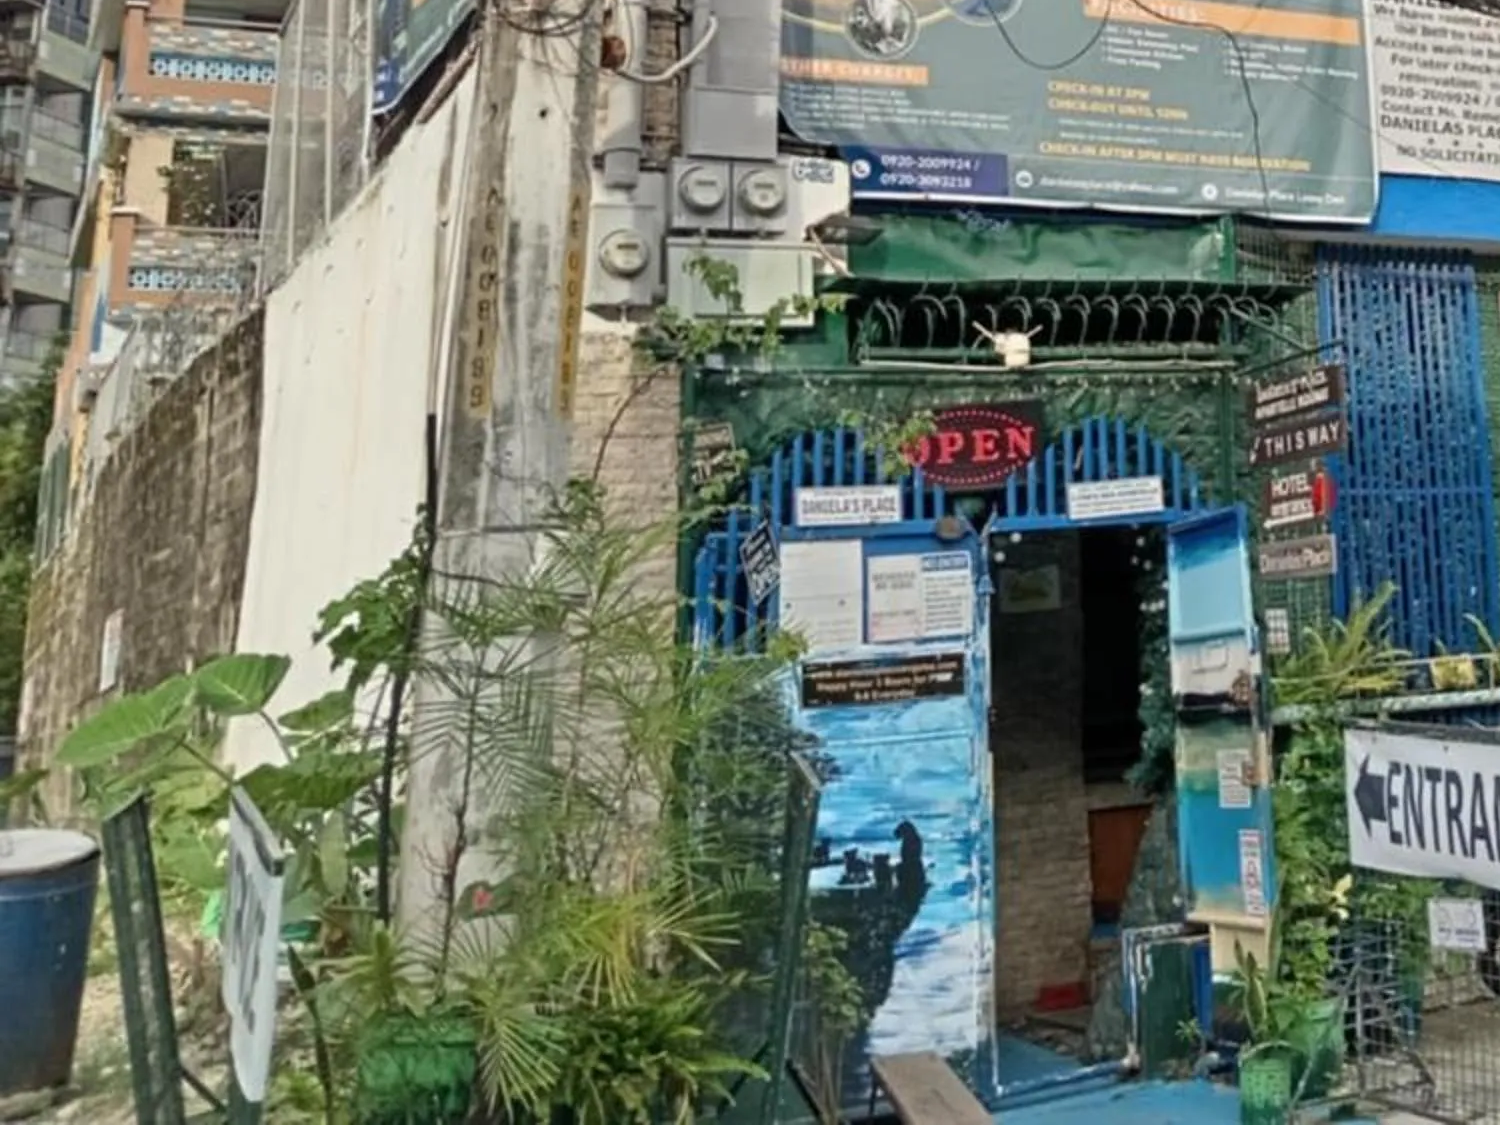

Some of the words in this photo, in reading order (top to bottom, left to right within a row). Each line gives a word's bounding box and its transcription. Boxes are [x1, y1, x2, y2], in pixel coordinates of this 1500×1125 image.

[1381, 100, 1435, 117] Contact
[1380, 114, 1465, 137] DANIELAS
[1396, 145, 1418, 159] NO
[903, 427, 1034, 465] OPEN
[1264, 430, 1305, 459] THIS
[1306, 420, 1340, 448] WAY
[1271, 472, 1313, 499] HOTEL
